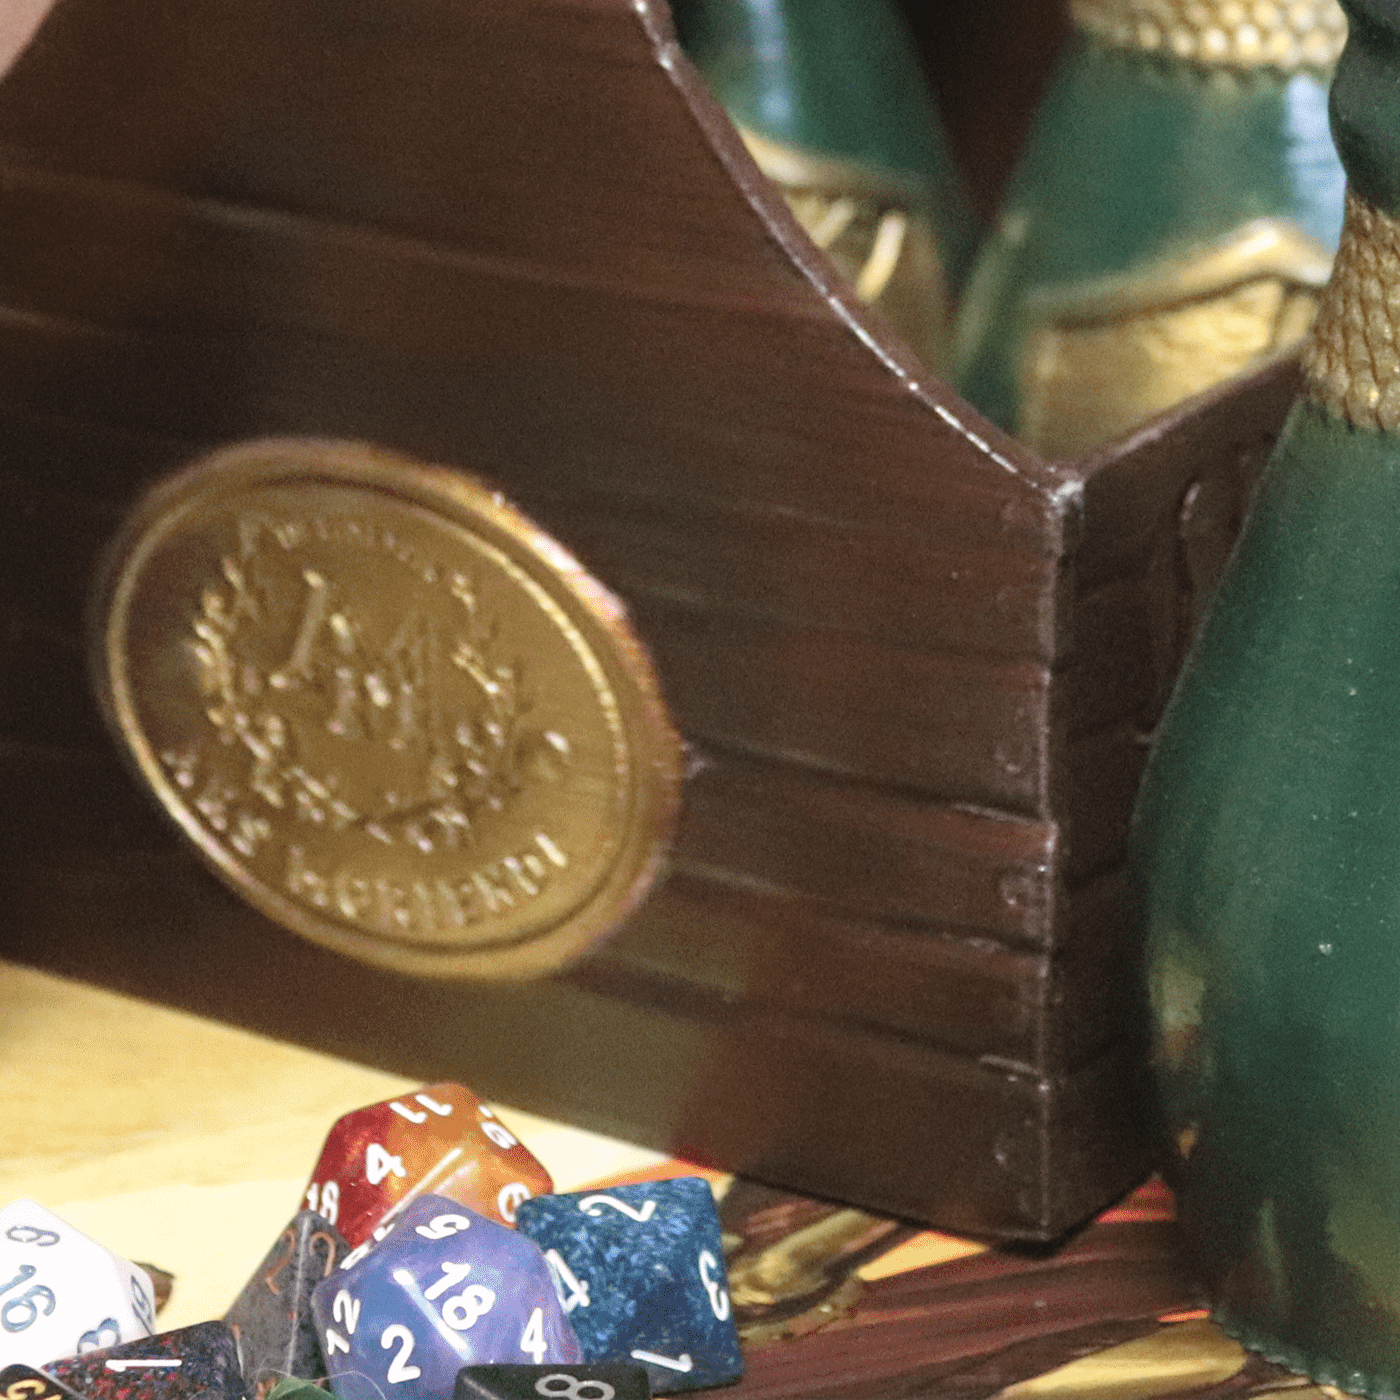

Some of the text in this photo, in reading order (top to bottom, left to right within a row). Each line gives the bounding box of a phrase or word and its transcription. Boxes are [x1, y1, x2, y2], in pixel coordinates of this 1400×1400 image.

[365, 1141, 407, 1186] 4
[423, 1260, 497, 1331] 18
[380, 1323, 422, 1385] 2
[519, 1307, 548, 1365] 4
